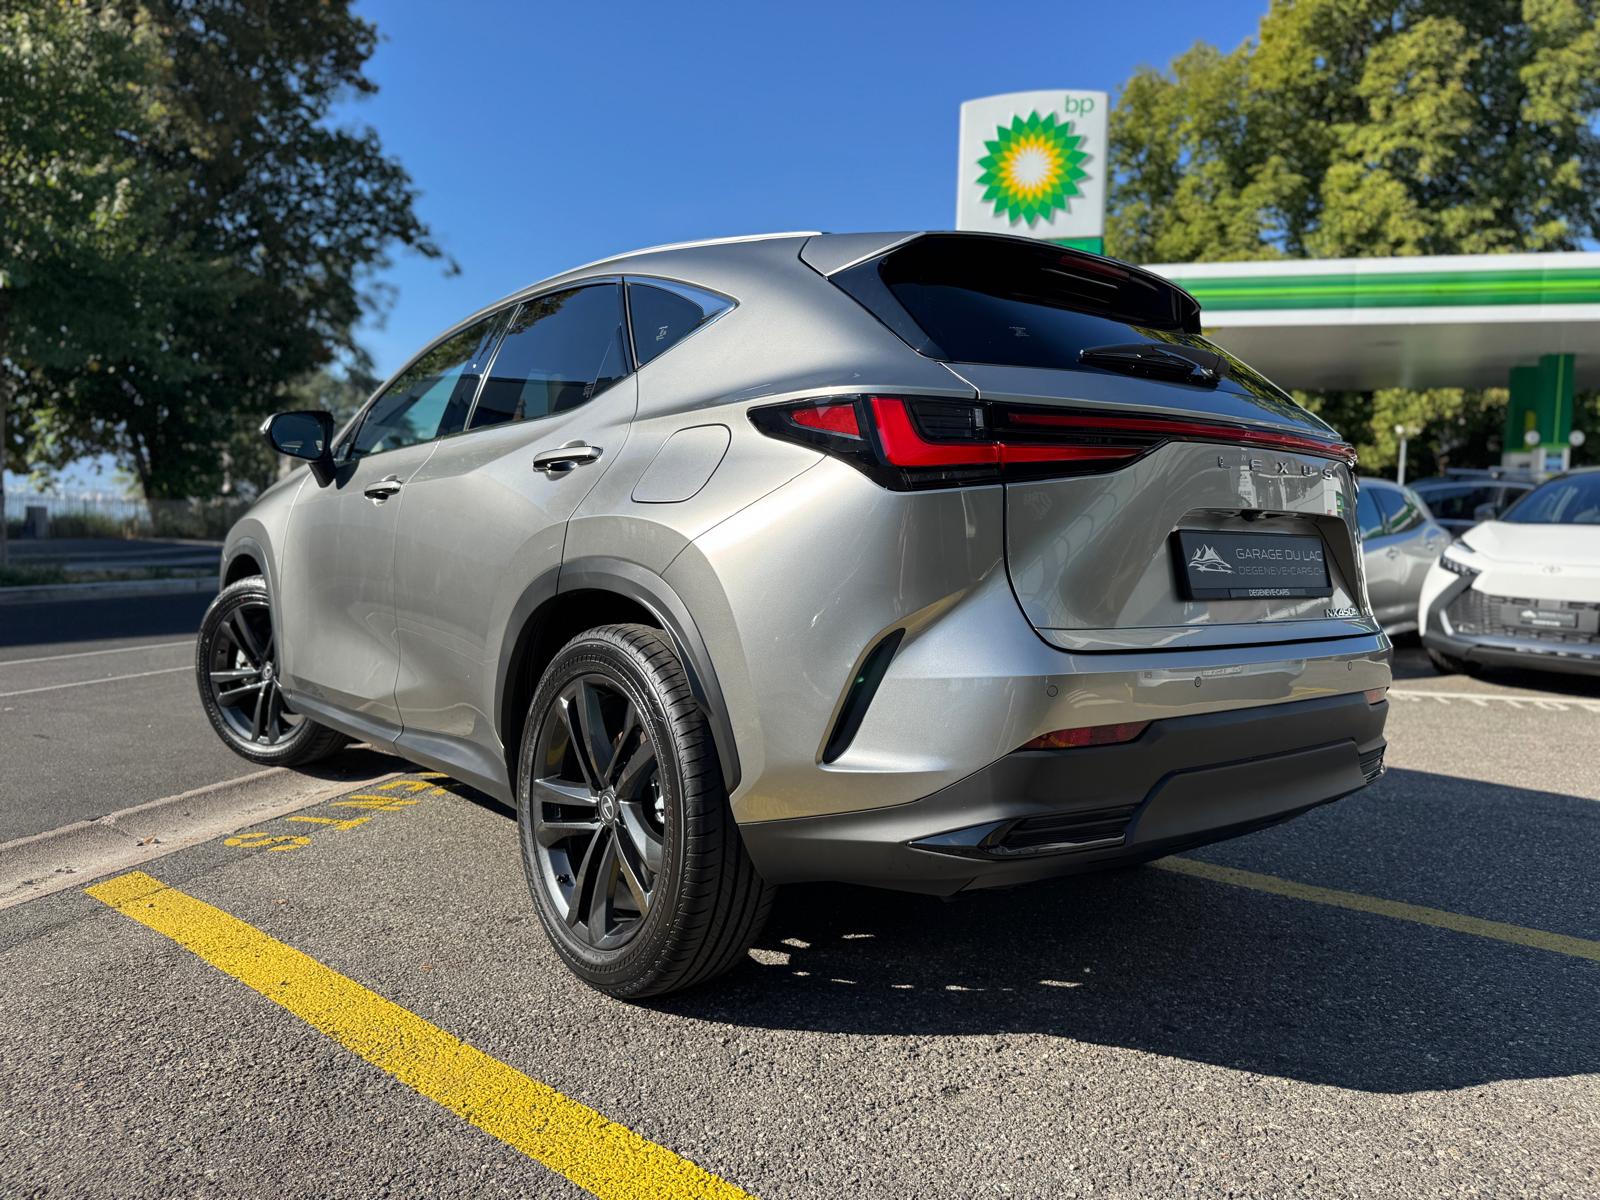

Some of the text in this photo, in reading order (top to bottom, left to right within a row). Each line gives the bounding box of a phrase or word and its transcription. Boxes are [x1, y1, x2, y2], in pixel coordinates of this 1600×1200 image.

[1065, 94, 1095, 117] bp
[1217, 456, 1333, 480] LEXUS
[1235, 548, 1323, 562] GARAGE DU LAC
